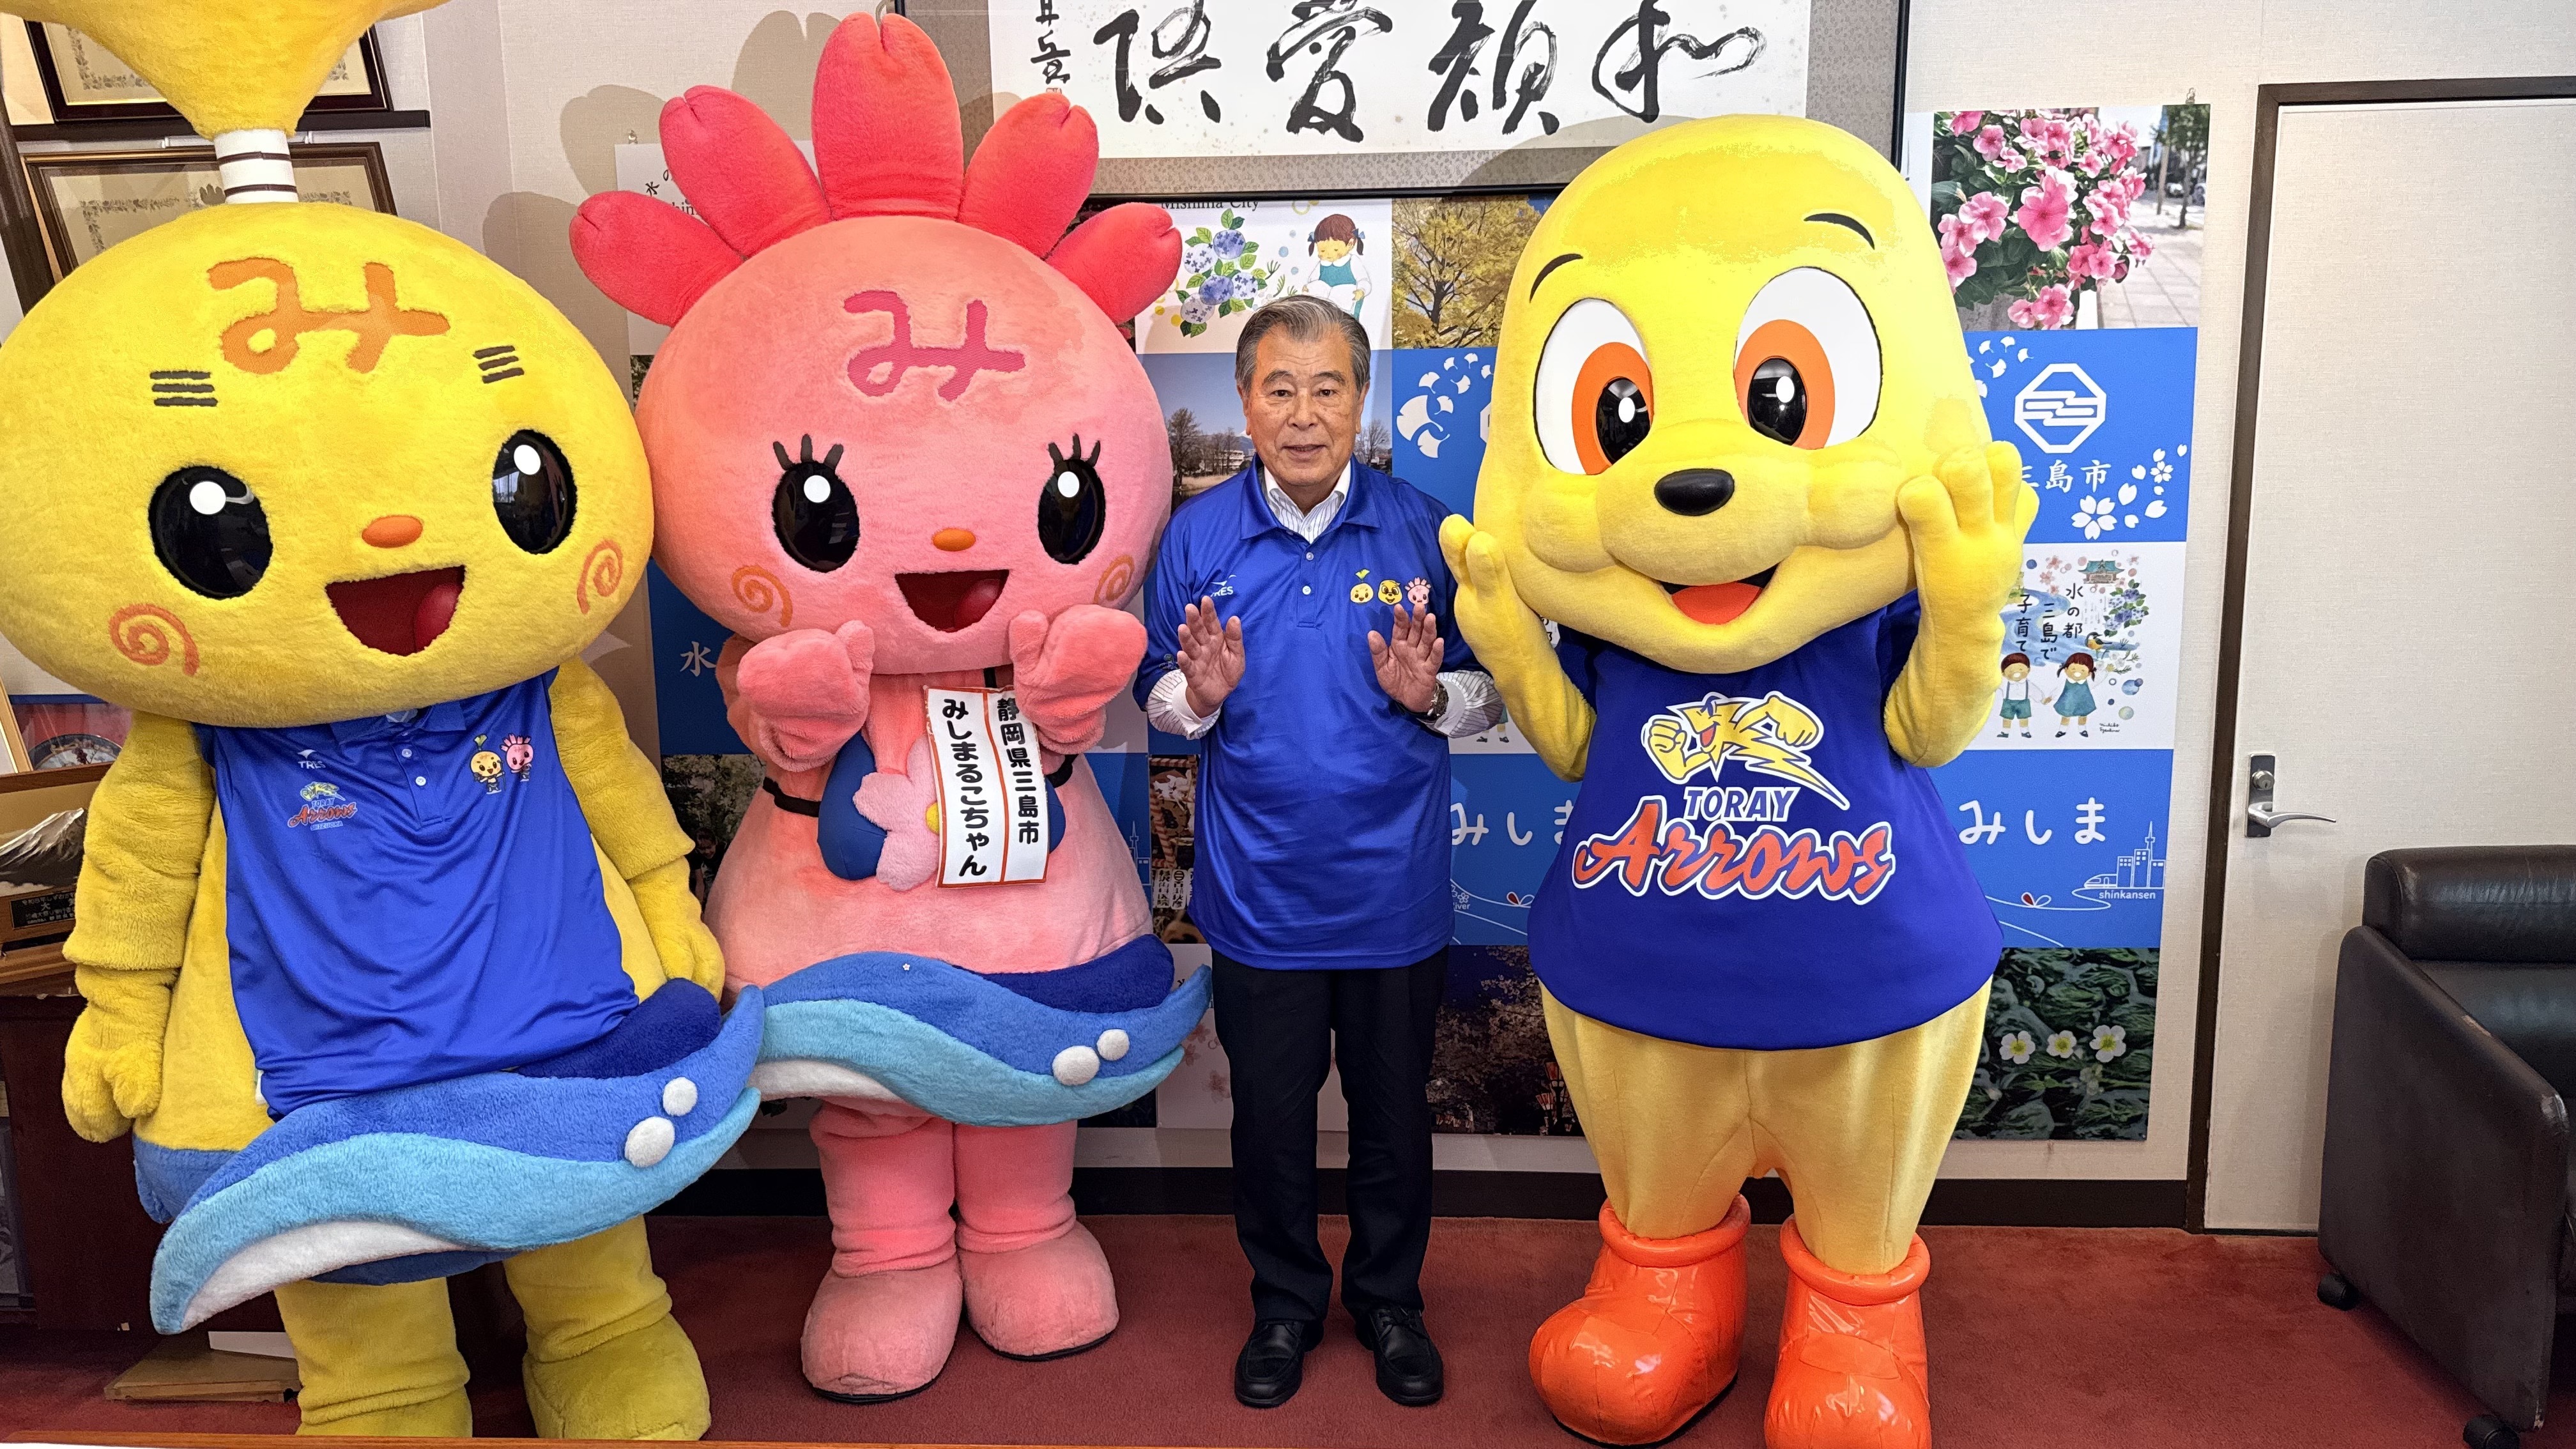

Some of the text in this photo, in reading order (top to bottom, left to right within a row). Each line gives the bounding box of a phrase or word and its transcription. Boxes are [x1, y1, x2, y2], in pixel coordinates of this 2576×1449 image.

[206, 257, 451, 374] み
[843, 289, 1026, 401] み
[2015, 594, 2033, 652] 子育て
[2040, 602, 2058, 660] 三島で
[2062, 583, 2084, 639] 水の都
[298, 760, 326, 769] TRES
[942, 698, 990, 877] みしまるこちゃん
[997, 697, 1039, 845] 静岡県三島市
[288, 802, 358, 827] Arrows
[312, 798, 335, 808] TORAY
[1684, 786, 1800, 821] TORAY
[1958, 797, 2106, 845] みしま
[1572, 796, 1895, 904] Arrows
[2099, 889, 2156, 899] shinkansen
